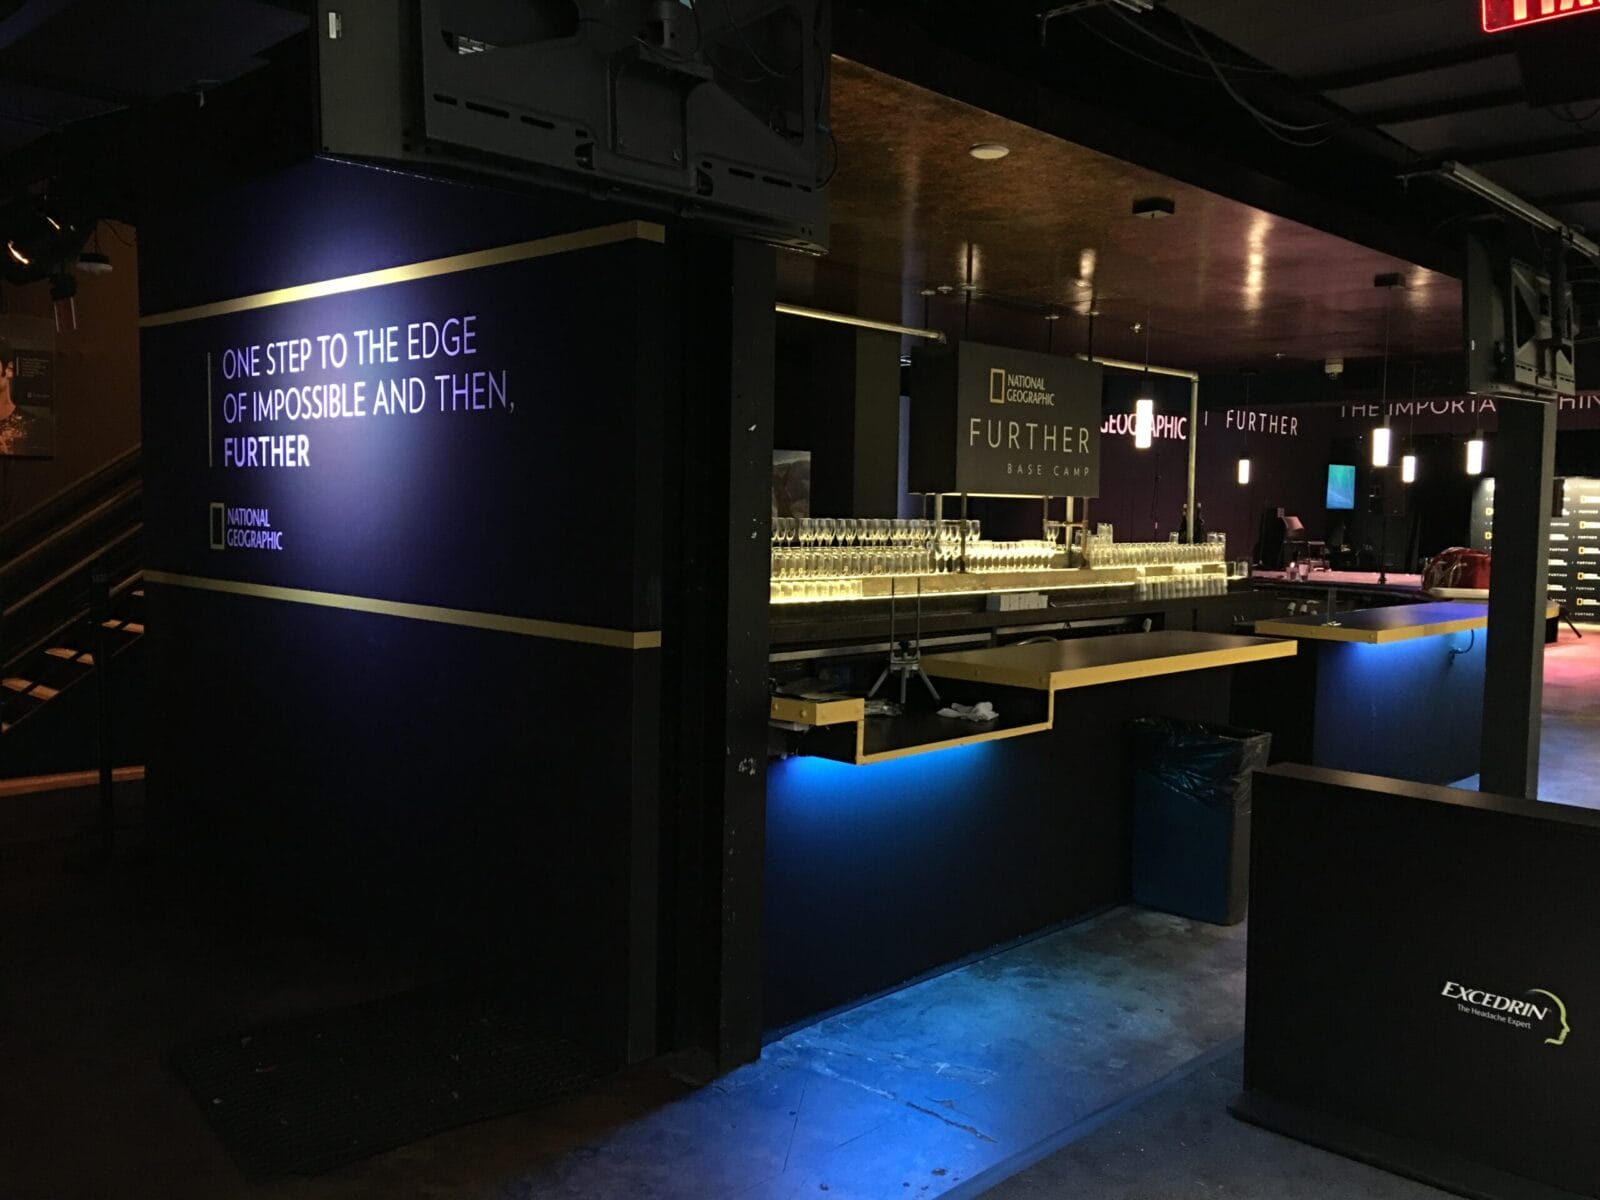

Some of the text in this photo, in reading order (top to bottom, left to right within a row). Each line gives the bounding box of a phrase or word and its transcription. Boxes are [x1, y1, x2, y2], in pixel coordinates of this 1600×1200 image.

[223, 315, 477, 380] ONE STEP TO THE EDGE
[1007, 373, 1046, 391] NATIONAL
[223, 369, 516, 424] OF IMPOSSIBLE AND THEN,
[1006, 389, 1055, 406] GEOGRAPHIC
[969, 417, 1091, 455] FURTHER
[1226, 409, 1299, 437] FURTHER
[224, 434, 311, 468] FURTHER
[1007, 463, 1090, 477] BASE CAMP
[226, 507, 271, 528] NATIONAL
[226, 529, 283, 551] GEOGRAPHIC
[1441, 980, 1549, 1021] EXCEDRIN
[1457, 1003, 1532, 1030] The Headache Expert
